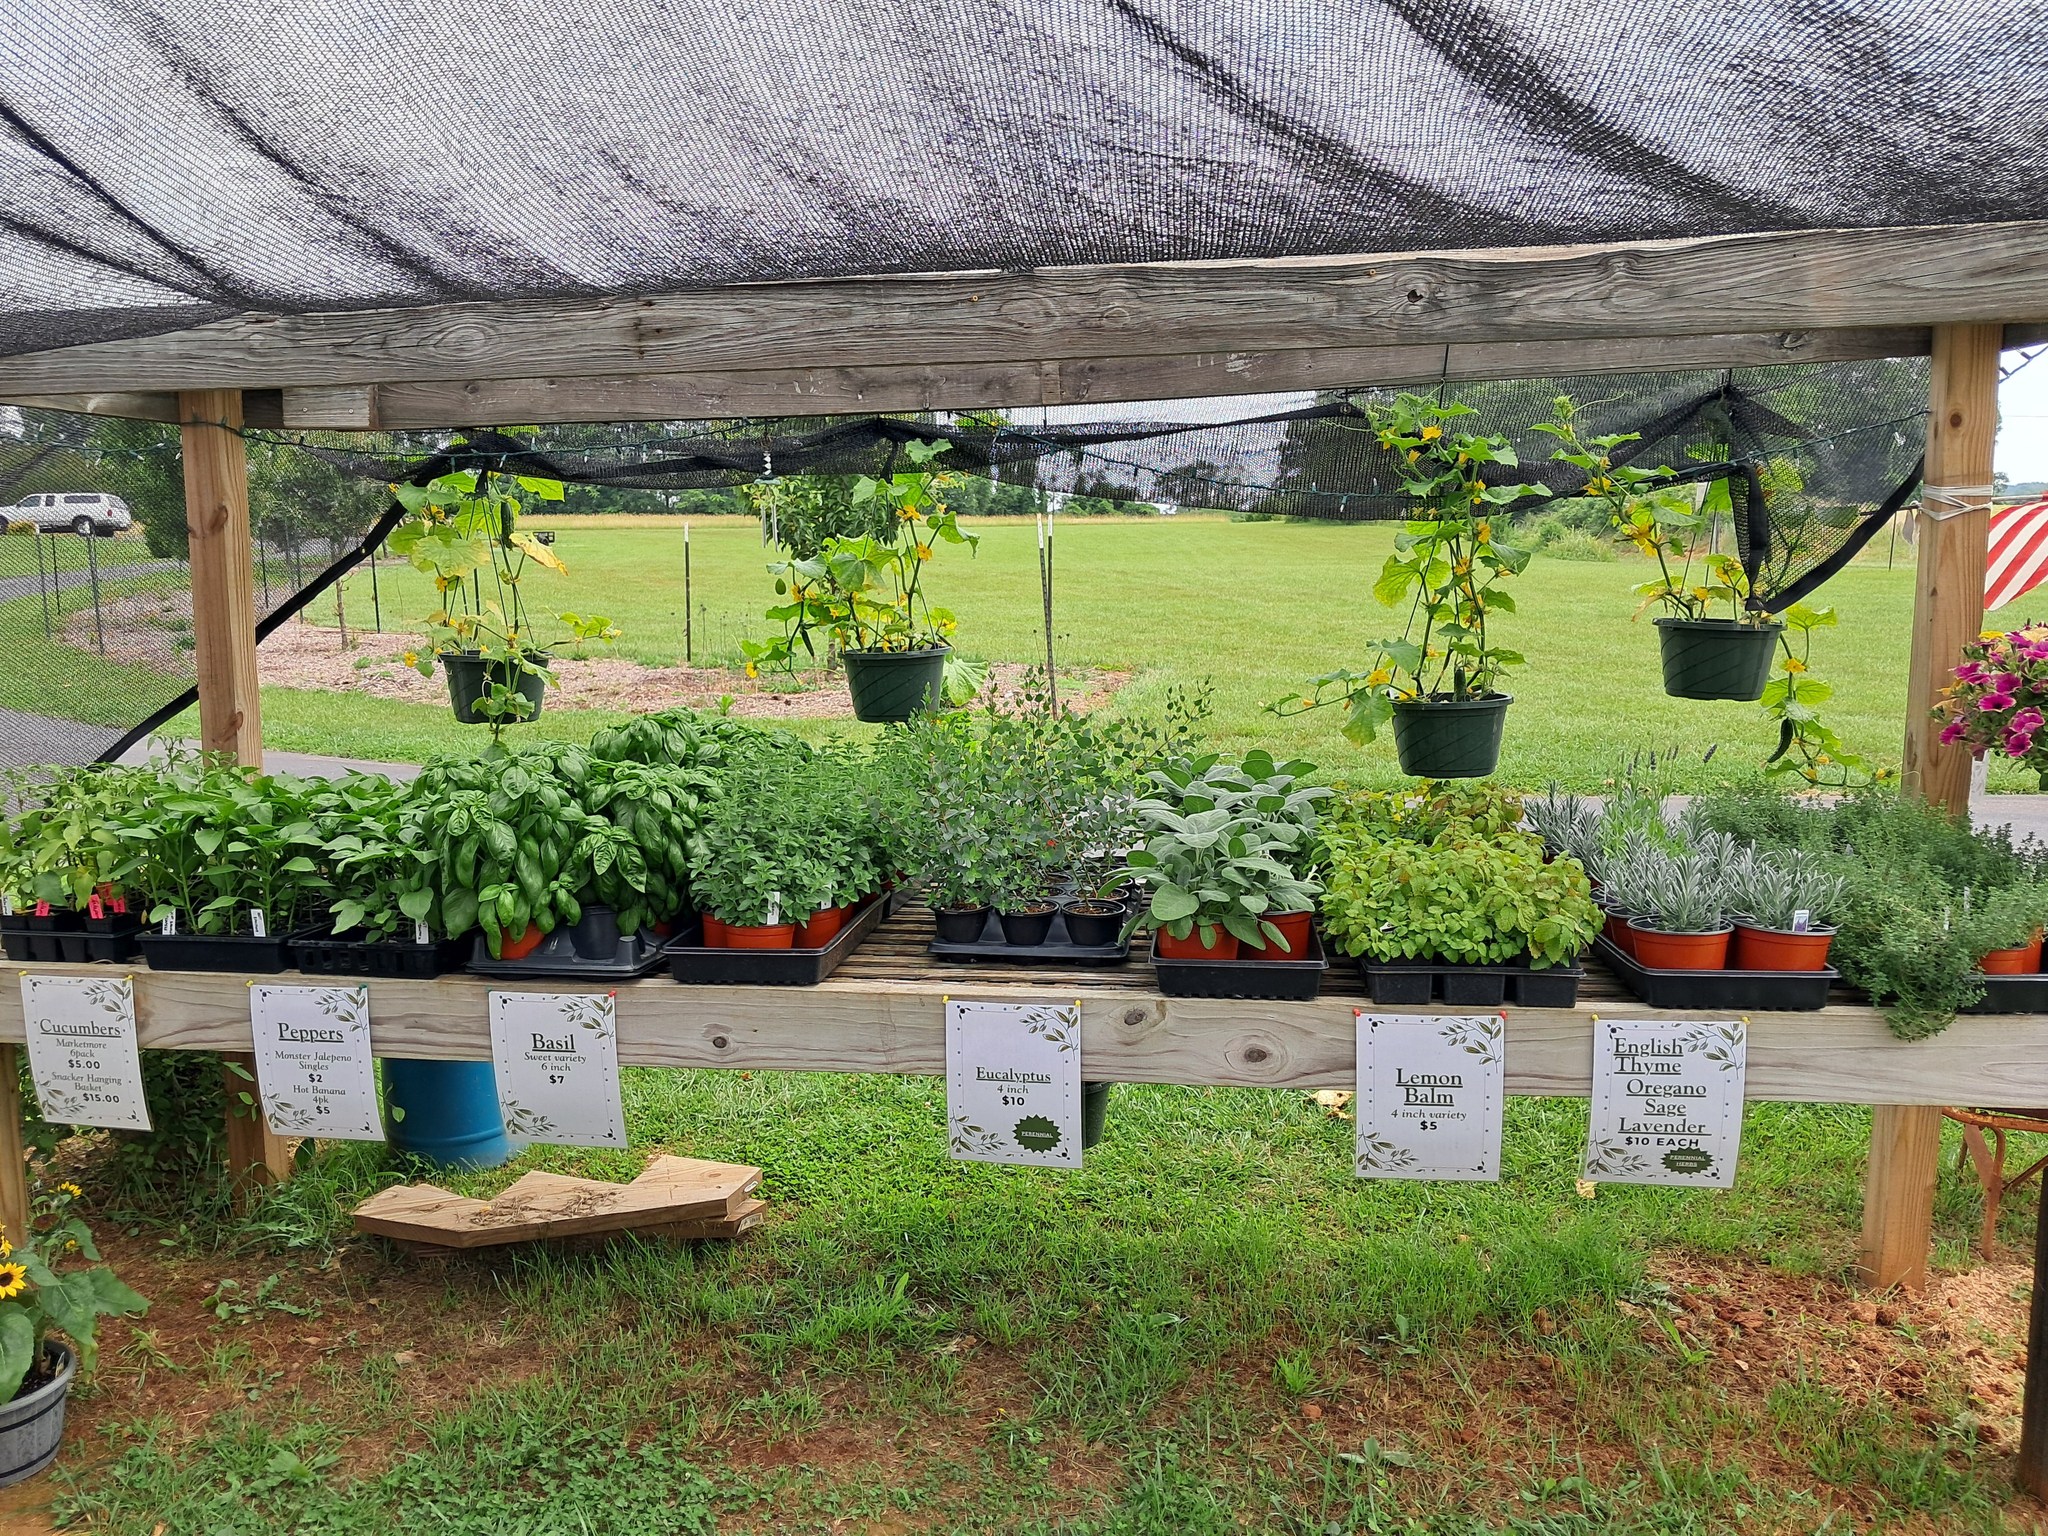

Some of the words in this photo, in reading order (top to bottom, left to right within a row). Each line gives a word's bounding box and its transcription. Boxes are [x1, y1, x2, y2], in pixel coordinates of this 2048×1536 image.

[40, 1018, 120, 1035] Cucumbers
[278, 1022, 344, 1043] Peppers
[56, 1038, 107, 1049] Marketmore
[531, 1033, 576, 1050] Basil
[1614, 1037, 1684, 1057] English
[70, 1050, 94, 1058] 6pack
[274, 1051, 311, 1060] Monster
[314, 1052, 352, 1063] Jalepeno
[524, 1052, 551, 1062] Sweet
[554, 1054, 586, 1064] variety
[68, 1059, 100, 1069] $5.00
[299, 1061, 328, 1071] Singles
[542, 1063, 548, 1071] 6
[550, 1063, 571, 1072] inch
[1614, 1056, 1682, 1076] Thyme
[51, 1072, 84, 1082] Snacker
[87, 1074, 122, 1085] Hanging
[308, 1074, 323, 1083] $2
[550, 1074, 564, 1084] $7
[976, 1066, 1051, 1084] Eucalyptus
[1396, 1068, 1463, 1085] Lemon
[74, 1083, 102, 1092] Basket
[293, 1085, 308, 1094] Hot
[312, 1086, 346, 1096] Banana
[997, 1085, 1004, 1094] 4
[1006, 1085, 1029, 1094] inch
[1626, 1078, 1706, 1098] Oregano
[83, 1093, 120, 1104] $15.00
[312, 1096, 328, 1104] 4pk
[1002, 1095, 1025, 1106] $10
[1404, 1088, 1454, 1104] Balm
[316, 1106, 330, 1115] $5
[1644, 1098, 1686, 1116] Sage
[1391, 1109, 1398, 1118] 4
[1402, 1109, 1426, 1118] inch
[1429, 1110, 1466, 1120] variety
[1420, 1120, 1438, 1131] $5
[1618, 1117, 1706, 1134] Lavender
[1625, 1136, 1650, 1146] $10
[1656, 1138, 1699, 1147] EACH
